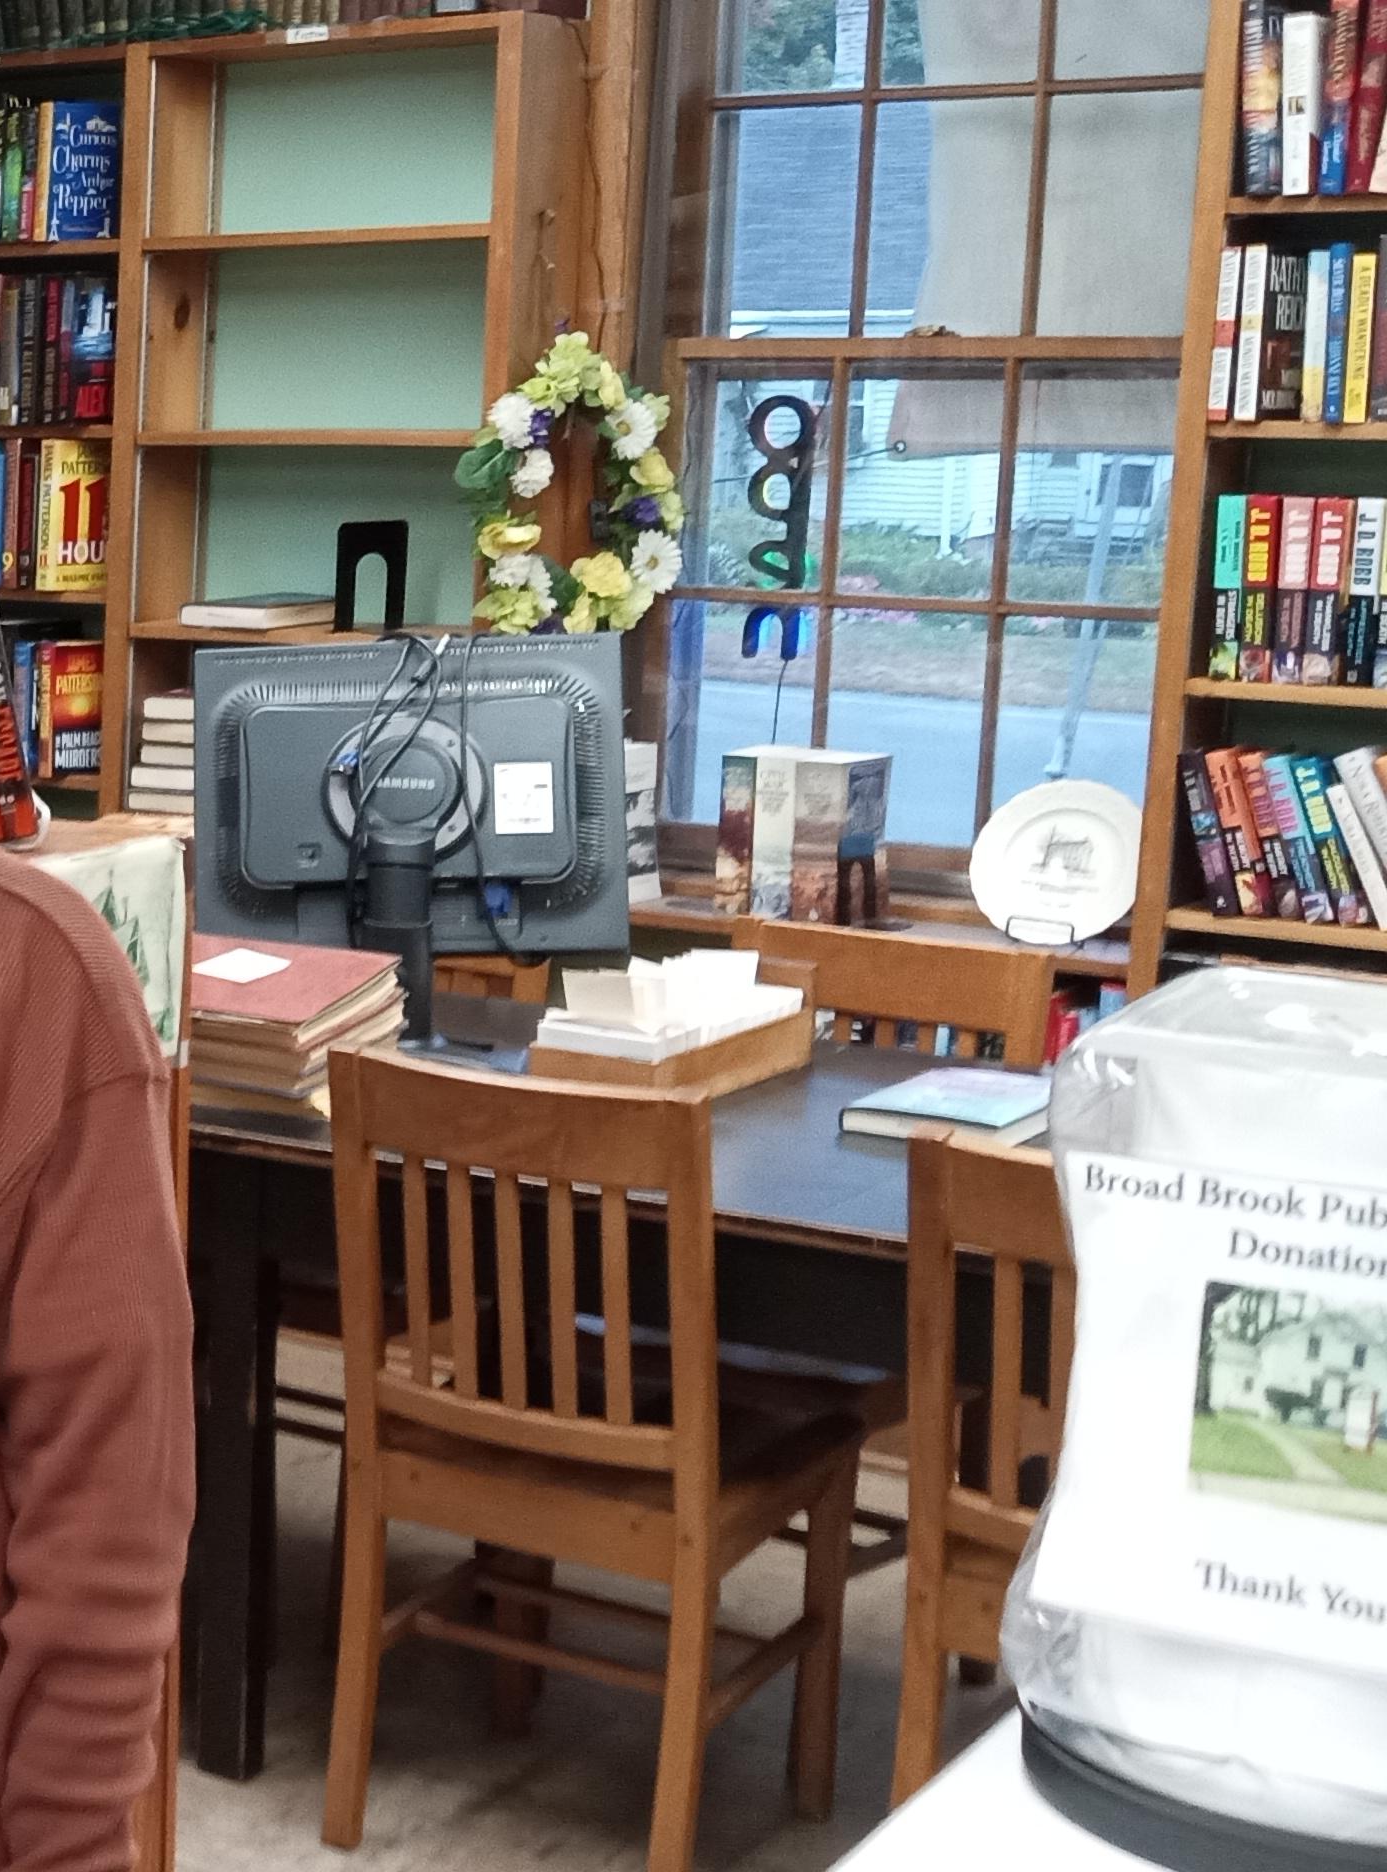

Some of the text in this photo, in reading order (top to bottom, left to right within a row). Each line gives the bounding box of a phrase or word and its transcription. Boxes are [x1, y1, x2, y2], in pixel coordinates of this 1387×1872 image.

[70, 124, 116, 147] Curious
[53, 145, 110, 173] Charms
[52, 184, 107, 216] Pepper
[1353, 276, 1369, 379] DEADLY WANDERING
[41, 444, 52, 554] JAMES PATTERSON
[1250, 508, 1271, 523] J.
[1322, 511, 1343, 526] J.
[2, 552, 13, 570] 9
[1247, 542, 1269, 582] ROBB
[1316, 544, 1340, 585] ROBB
[1354, 513, 1377, 586] J. D. ROBB
[1085, 1162, 1387, 1229] Broad Brook Pub
[1194, 1559, 1386, 1624] Thank You
